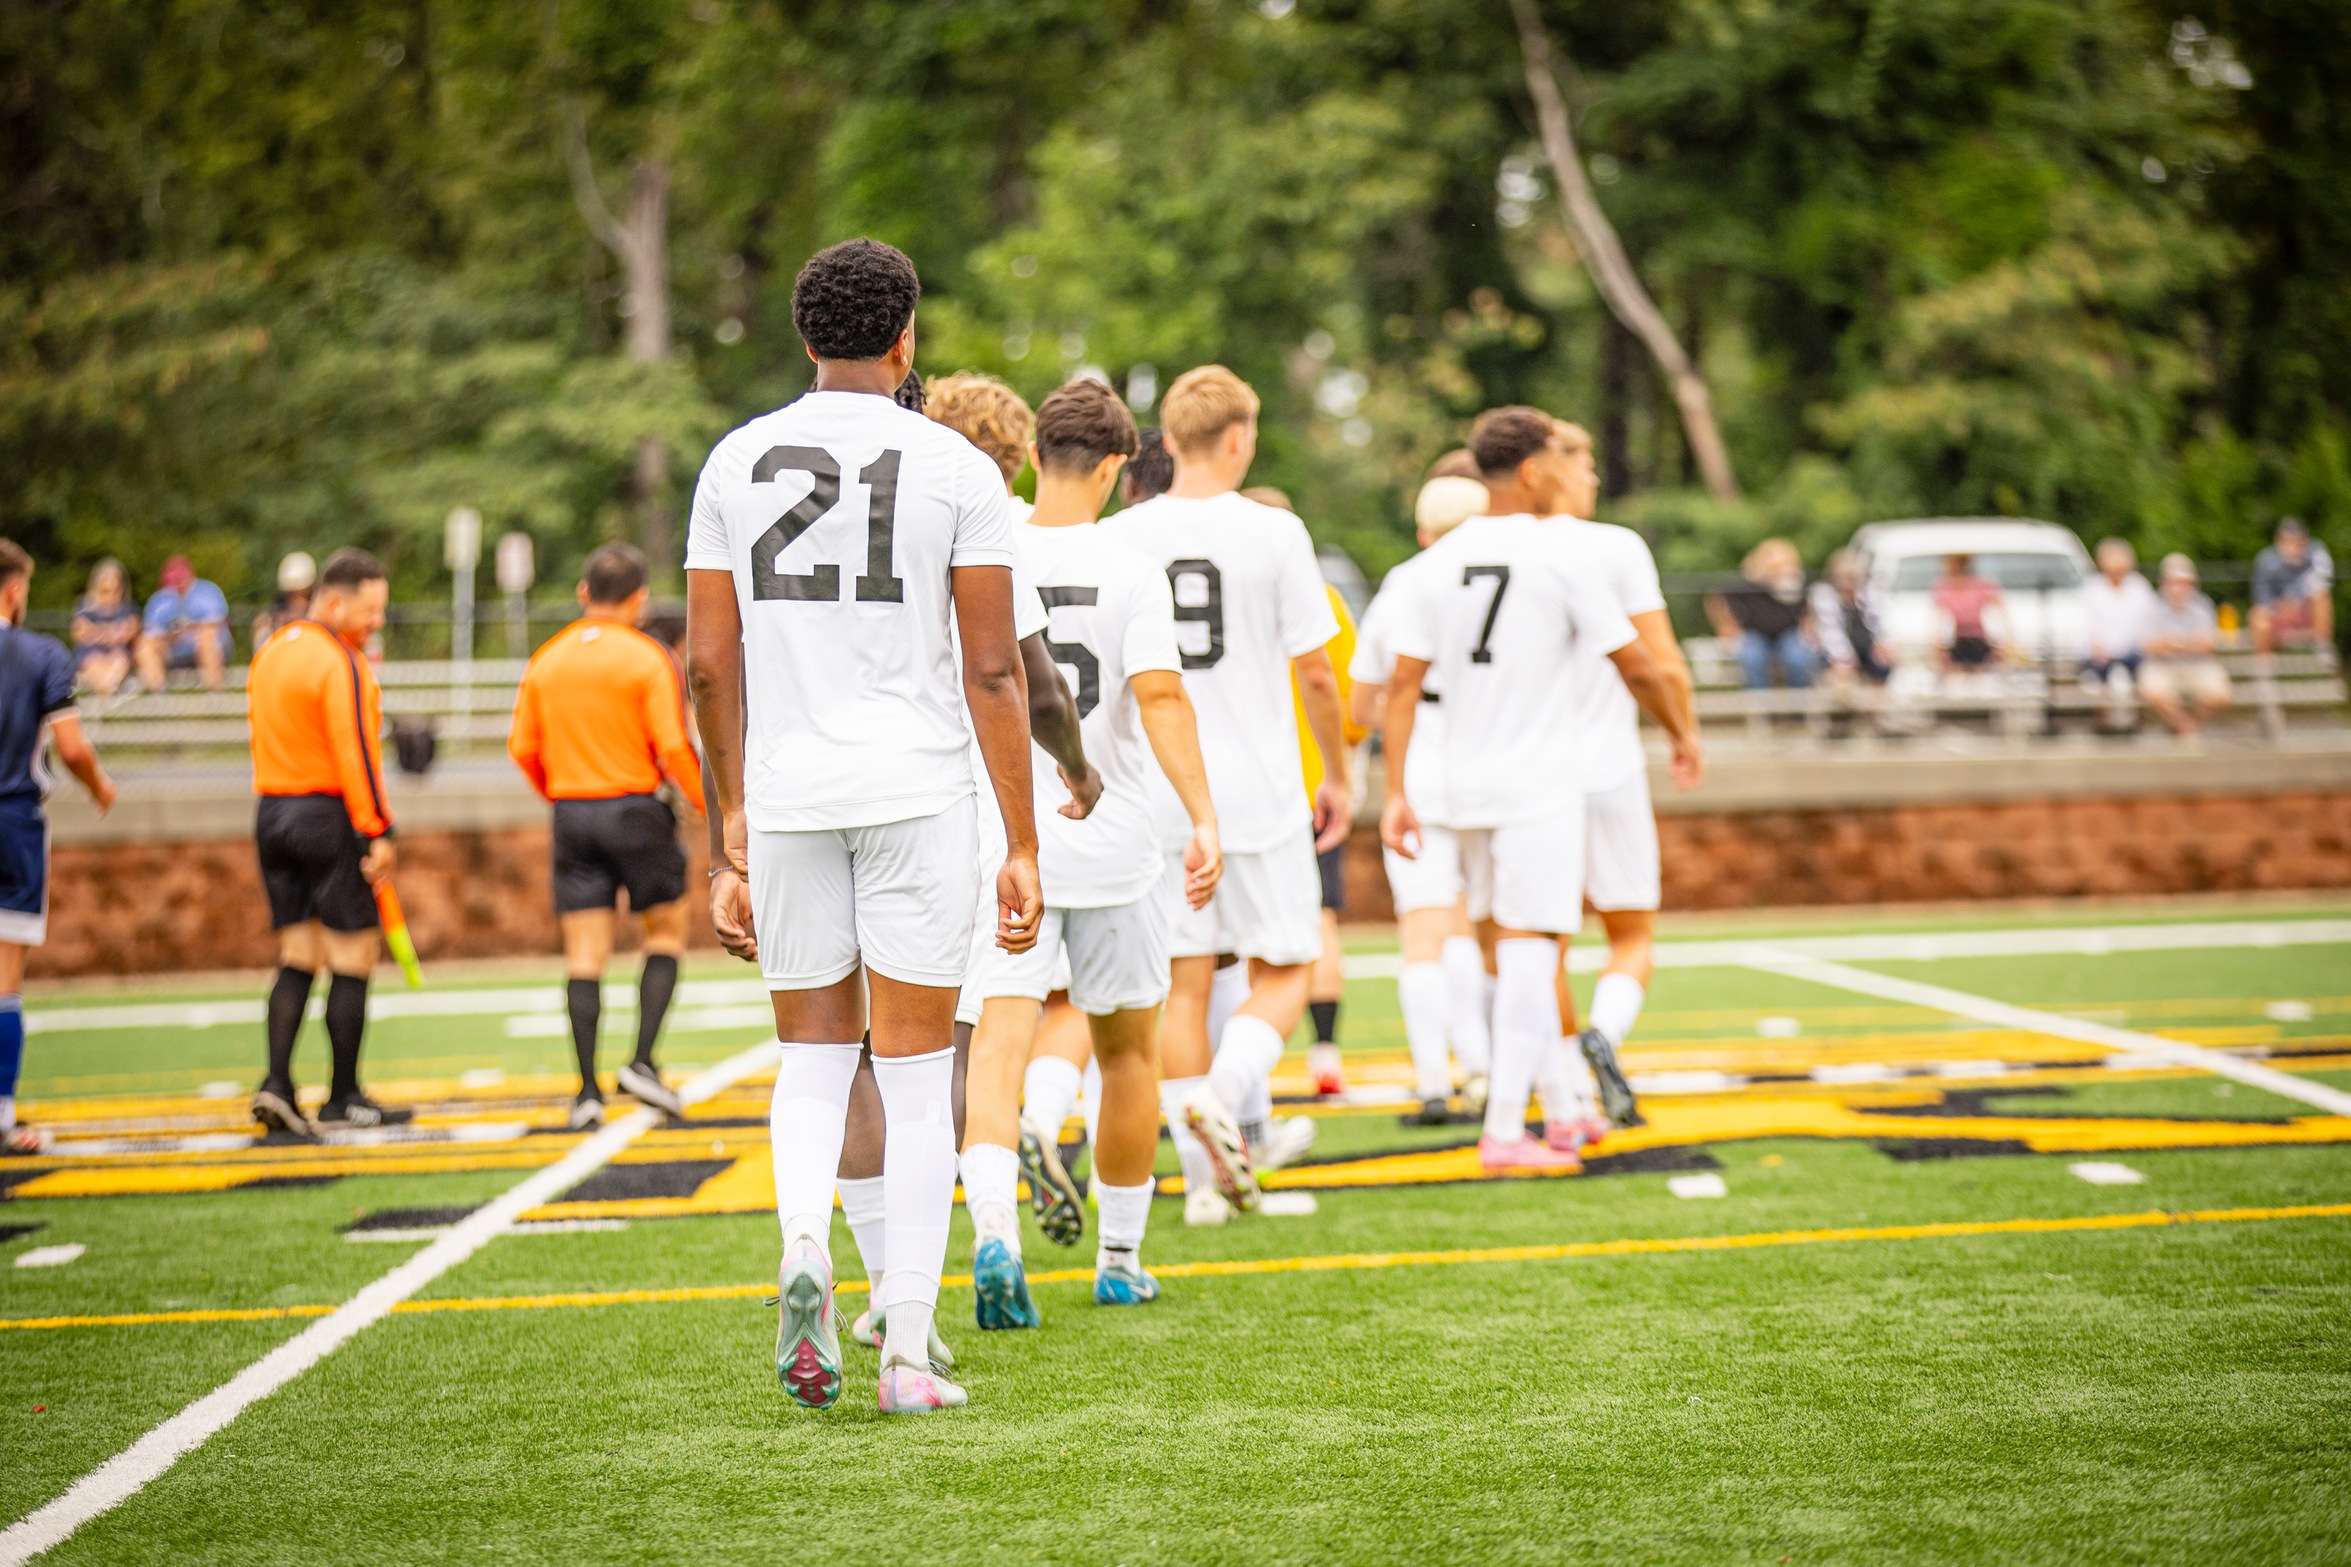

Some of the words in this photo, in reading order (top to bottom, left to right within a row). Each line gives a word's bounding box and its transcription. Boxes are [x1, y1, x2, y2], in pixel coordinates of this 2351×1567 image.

[751, 445, 904, 603] 21
[1036, 586, 1099, 720] 5
[1165, 559, 1224, 669] 9
[1463, 565, 1510, 663] 7
